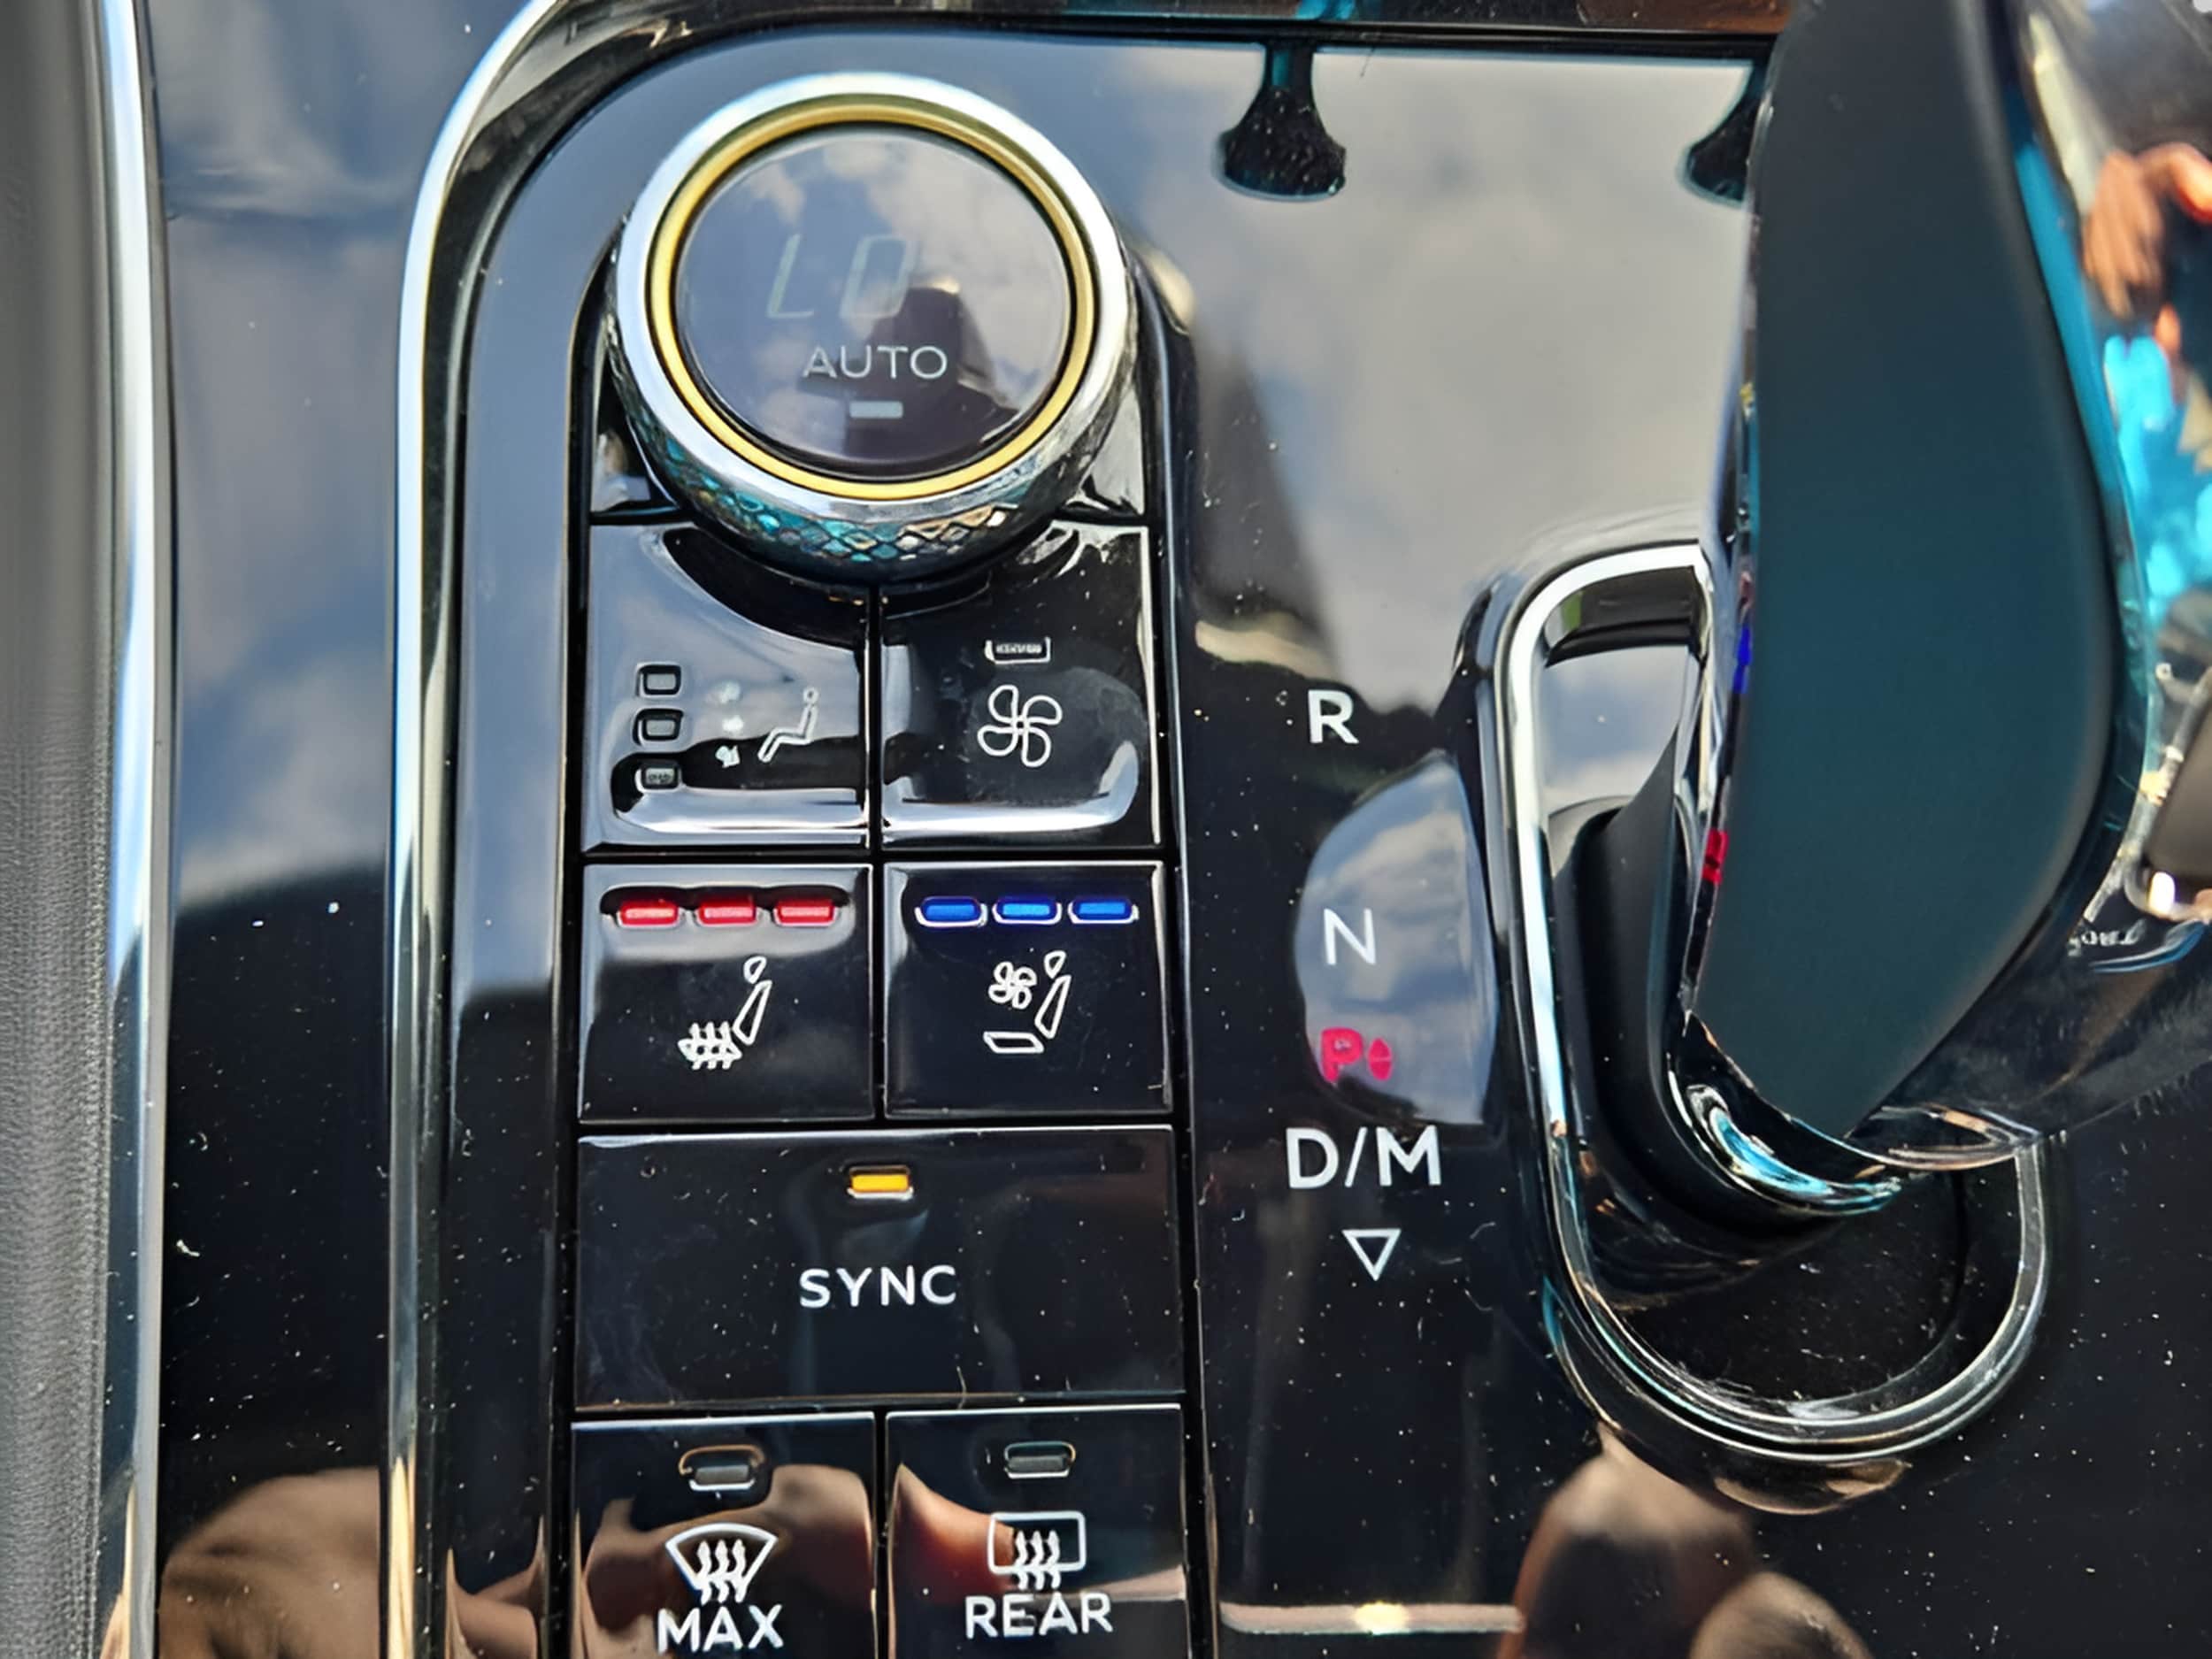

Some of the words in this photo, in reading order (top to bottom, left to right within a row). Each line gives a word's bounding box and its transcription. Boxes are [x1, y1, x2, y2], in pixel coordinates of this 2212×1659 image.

[803, 344, 948, 379] AUTO
[1308, 688, 1359, 745] R
[1323, 908, 1377, 965] N
[1286, 1124, 1441, 1189] D/M
[799, 1264, 957, 1308] SYNC
[657, 1602, 784, 1653] MAX
[964, 1593, 1114, 1639] REAR
